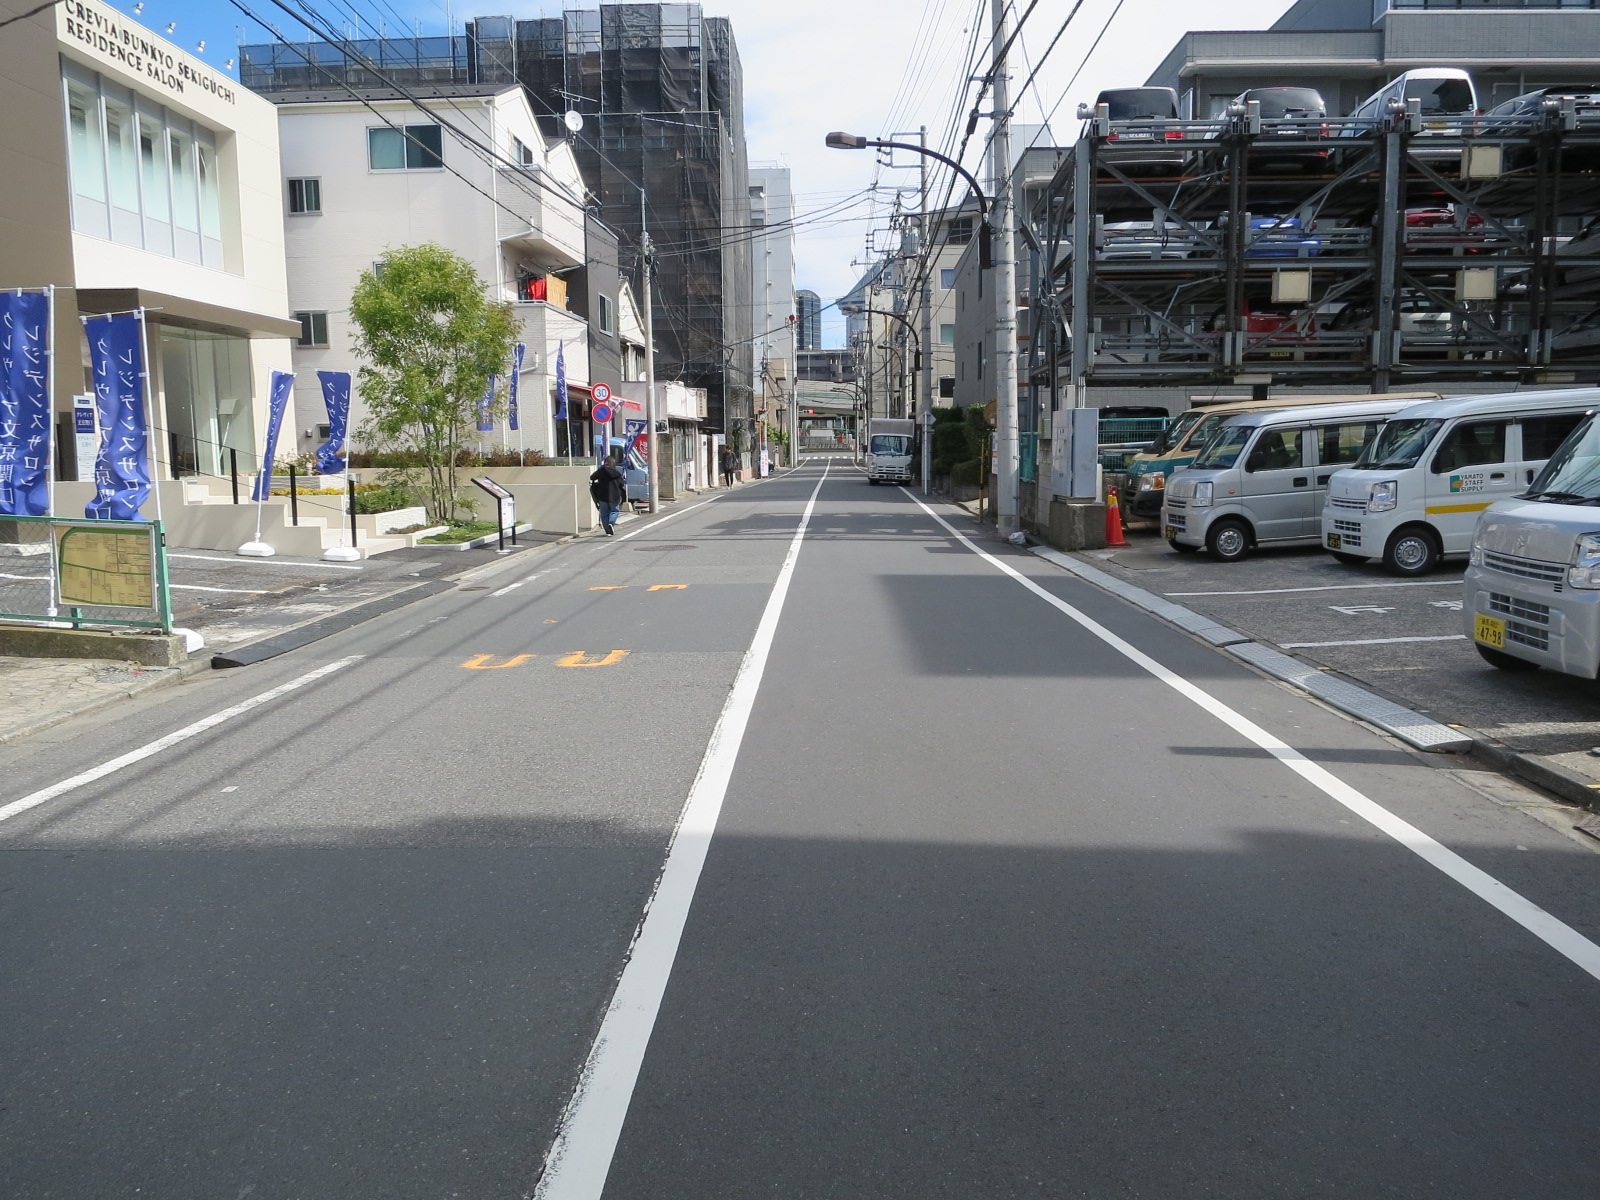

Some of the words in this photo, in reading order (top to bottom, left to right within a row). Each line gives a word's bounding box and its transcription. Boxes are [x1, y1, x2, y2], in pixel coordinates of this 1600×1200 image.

[65, 0, 118, 39] CREVIA
[123, 29, 174, 70] BUNKYO
[178, 62, 236, 105] SEKIGUCHI
[66, 17, 143, 72] RESIDENCE
[147, 62, 185, 94] SALON
[596, 388, 607, 398] 30
[1480, 626, 1502, 645] 47-98
